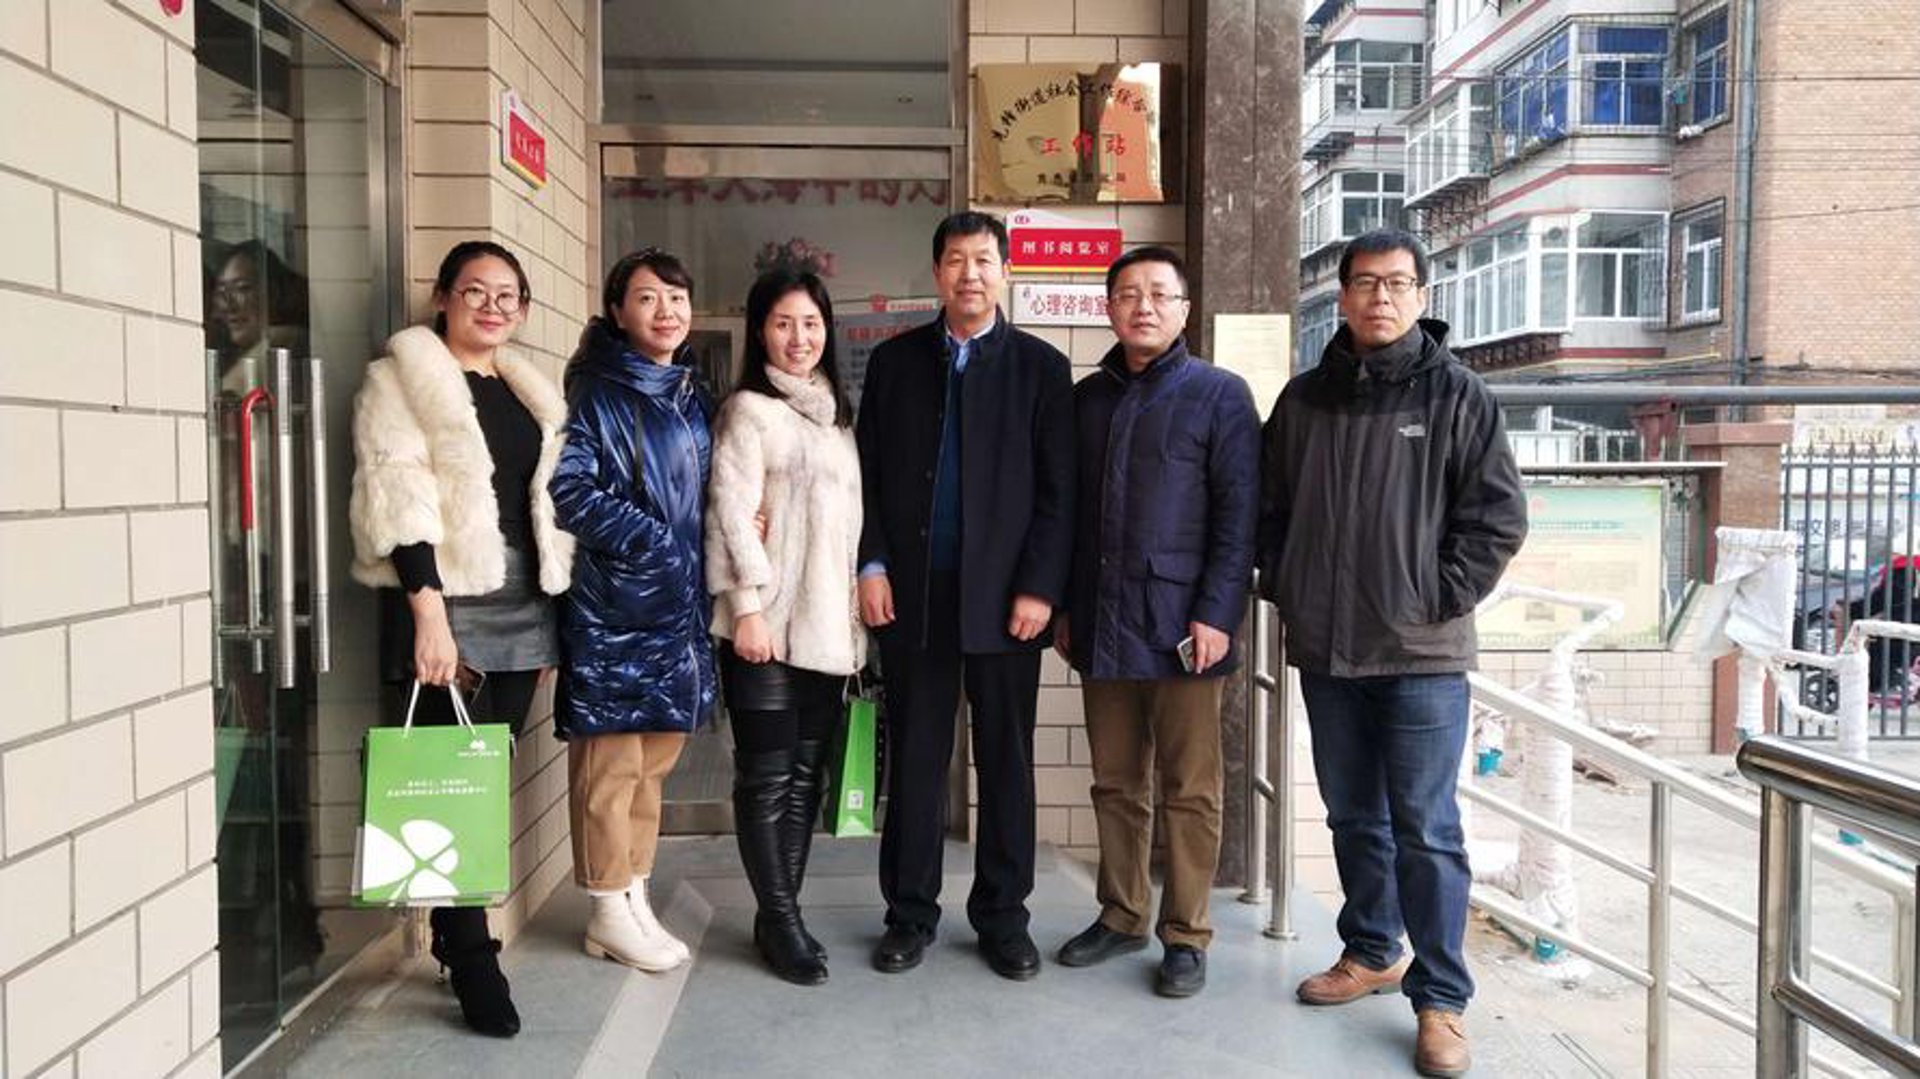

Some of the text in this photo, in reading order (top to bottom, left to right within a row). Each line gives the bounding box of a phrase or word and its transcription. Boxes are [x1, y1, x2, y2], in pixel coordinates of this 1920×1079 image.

[1041, 131, 1126, 160] 工作站
[1022, 241, 1110, 255] 图书阅览室
[1030, 293, 1109, 316] 心理咨询室
